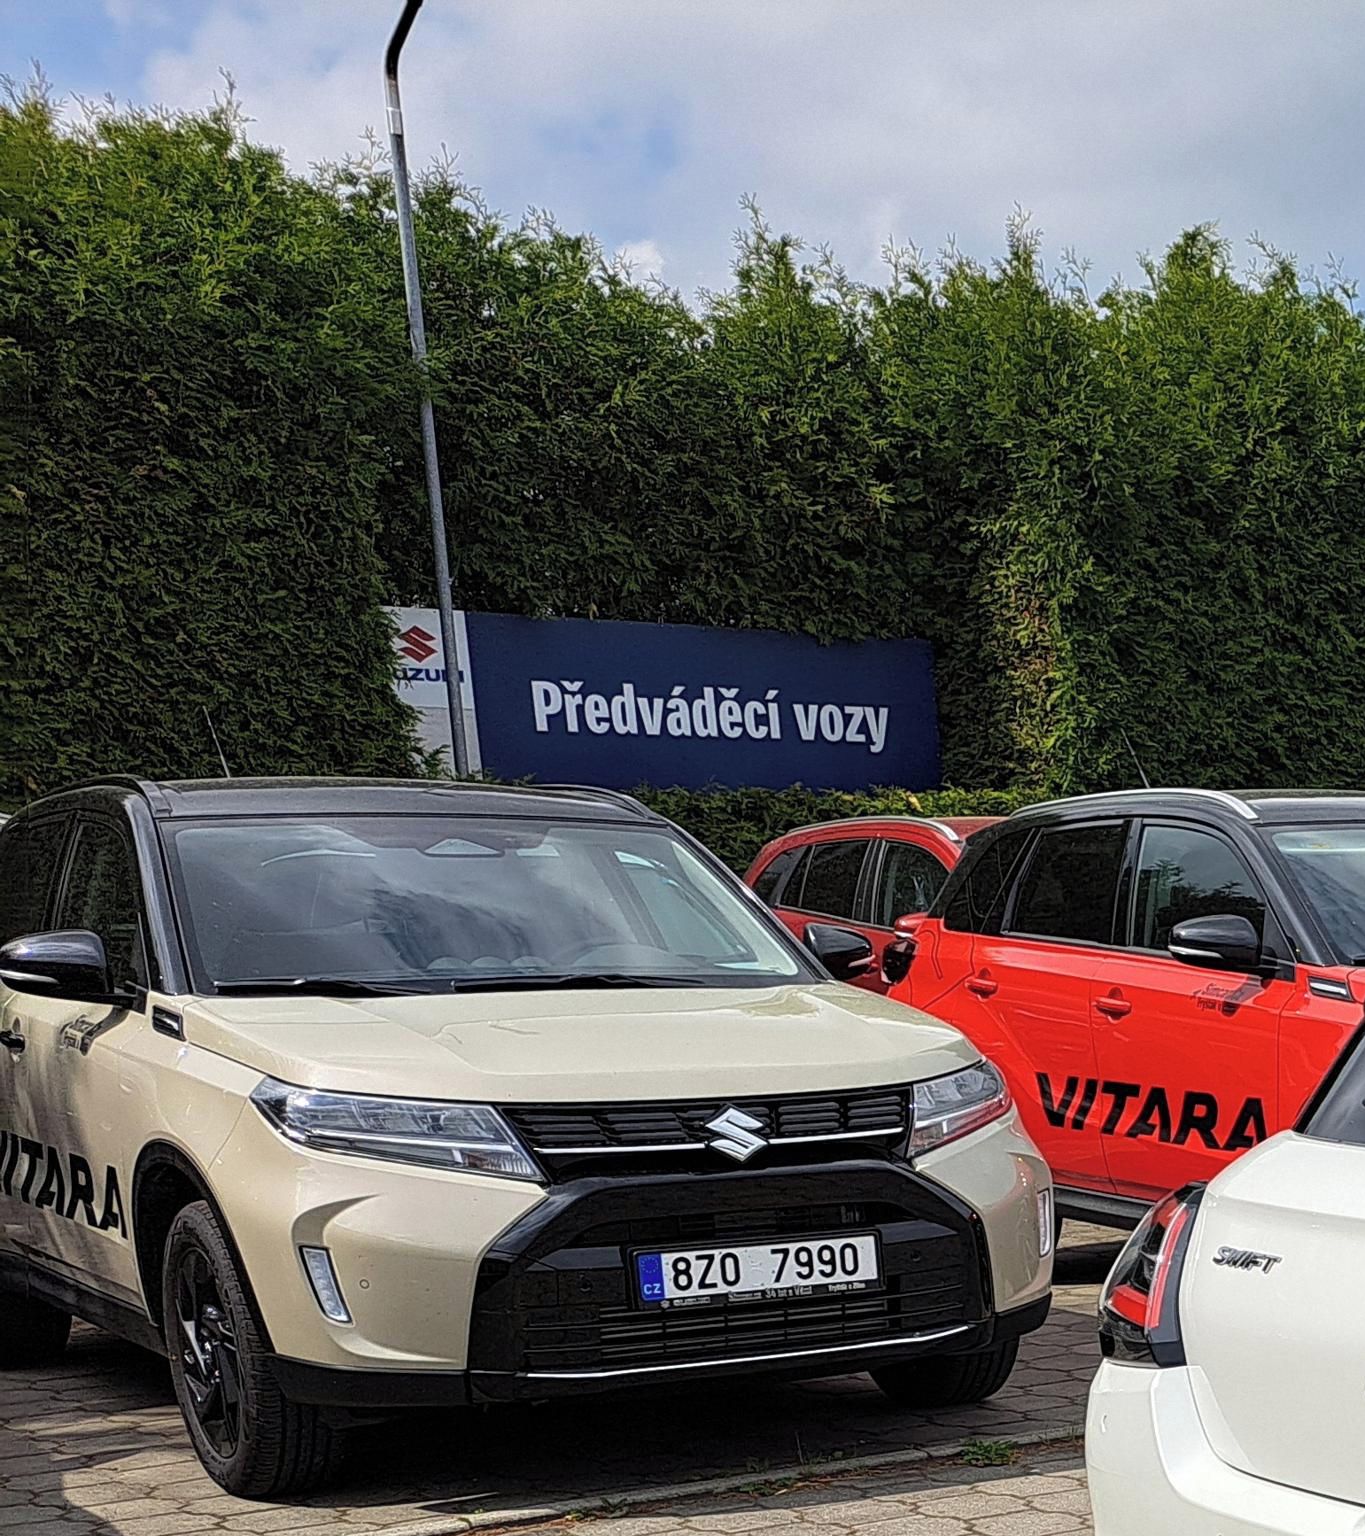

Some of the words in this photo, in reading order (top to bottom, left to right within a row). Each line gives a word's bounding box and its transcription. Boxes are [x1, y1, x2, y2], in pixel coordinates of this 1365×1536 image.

[530, 679, 781, 740] Předváděcí
[792, 702, 889, 754] vozy
[1035, 1071, 1268, 1151] VITARA
[770, 1243, 860, 1284] 7990
[1212, 1246, 1283, 1274] SWIFT
[643, 1282, 661, 1296] CZ
